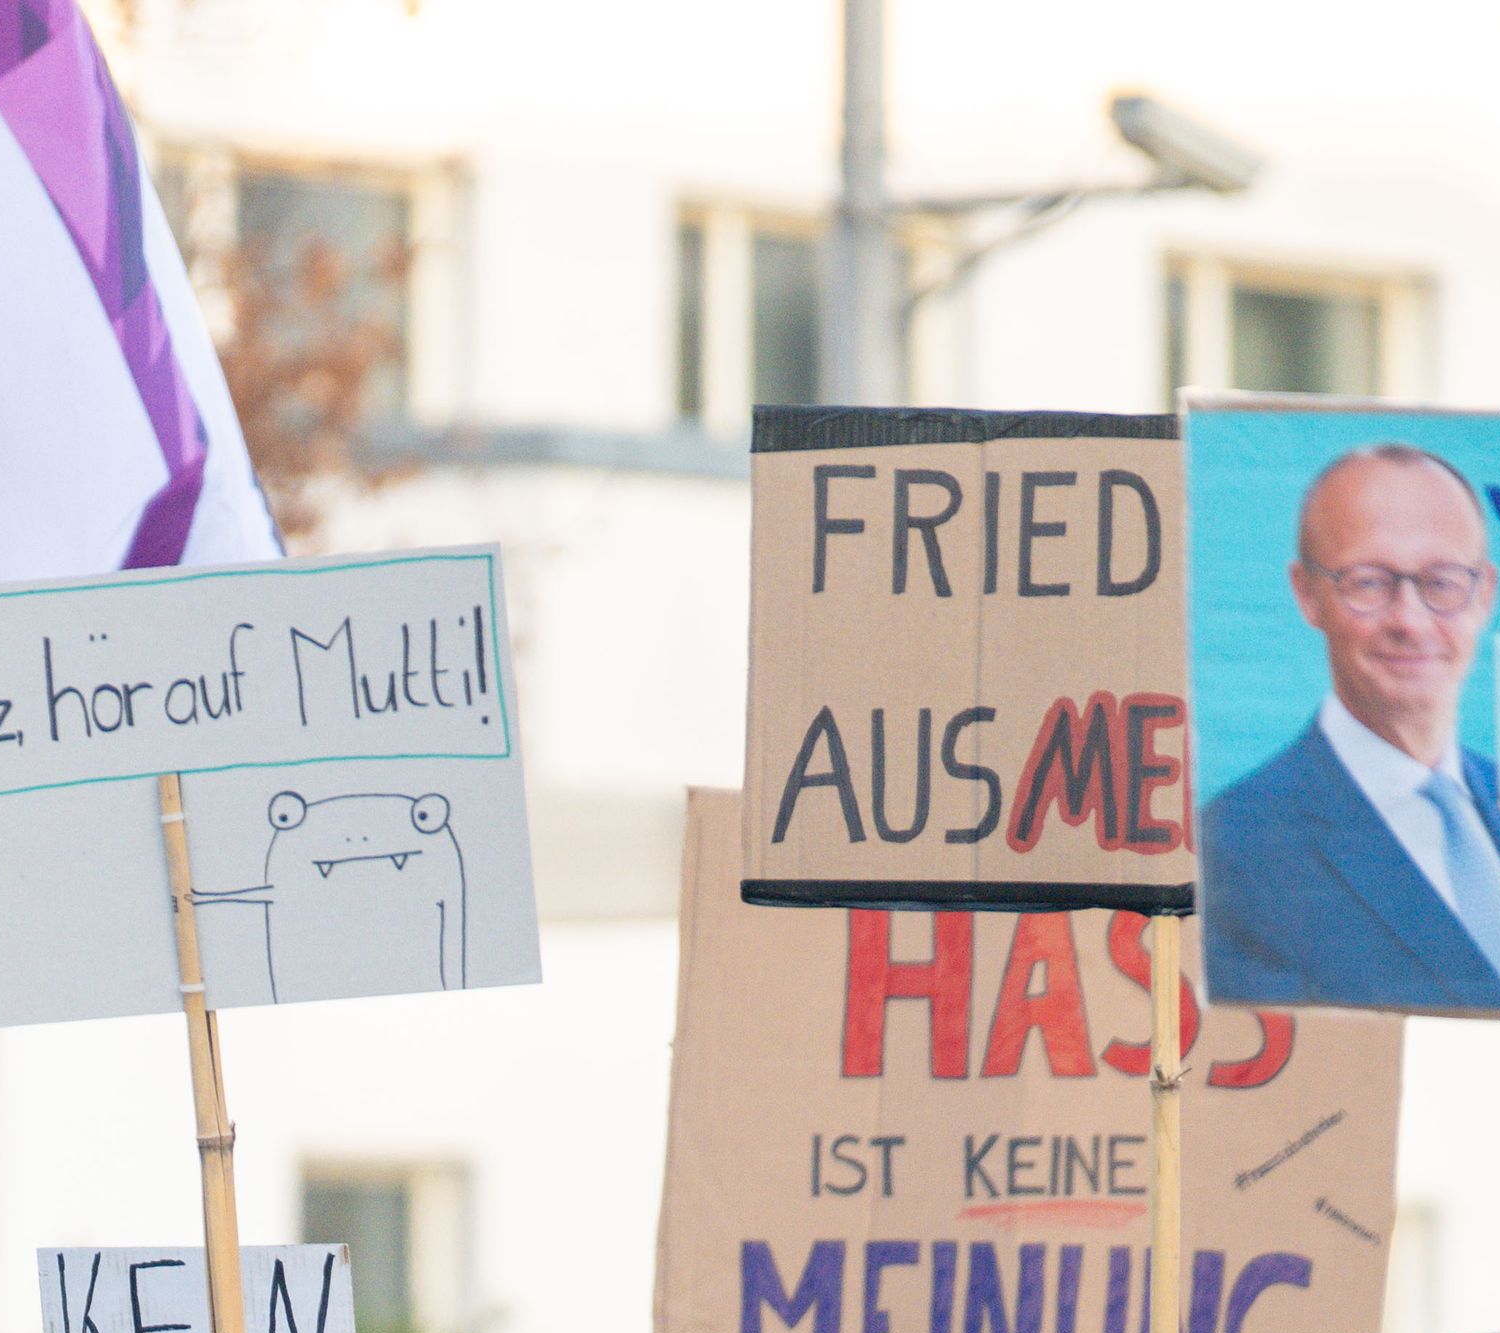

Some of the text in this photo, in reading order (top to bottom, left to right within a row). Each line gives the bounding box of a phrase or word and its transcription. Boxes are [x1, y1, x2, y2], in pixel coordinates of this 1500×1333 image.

[42, 632, 154, 742] hör
[164, 622, 254, 725] auf
[290, 604, 490, 727] Mutti!
[772, 692, 1193, 856] AUSME
[811, 1133, 1149, 1201] IST KEINE
